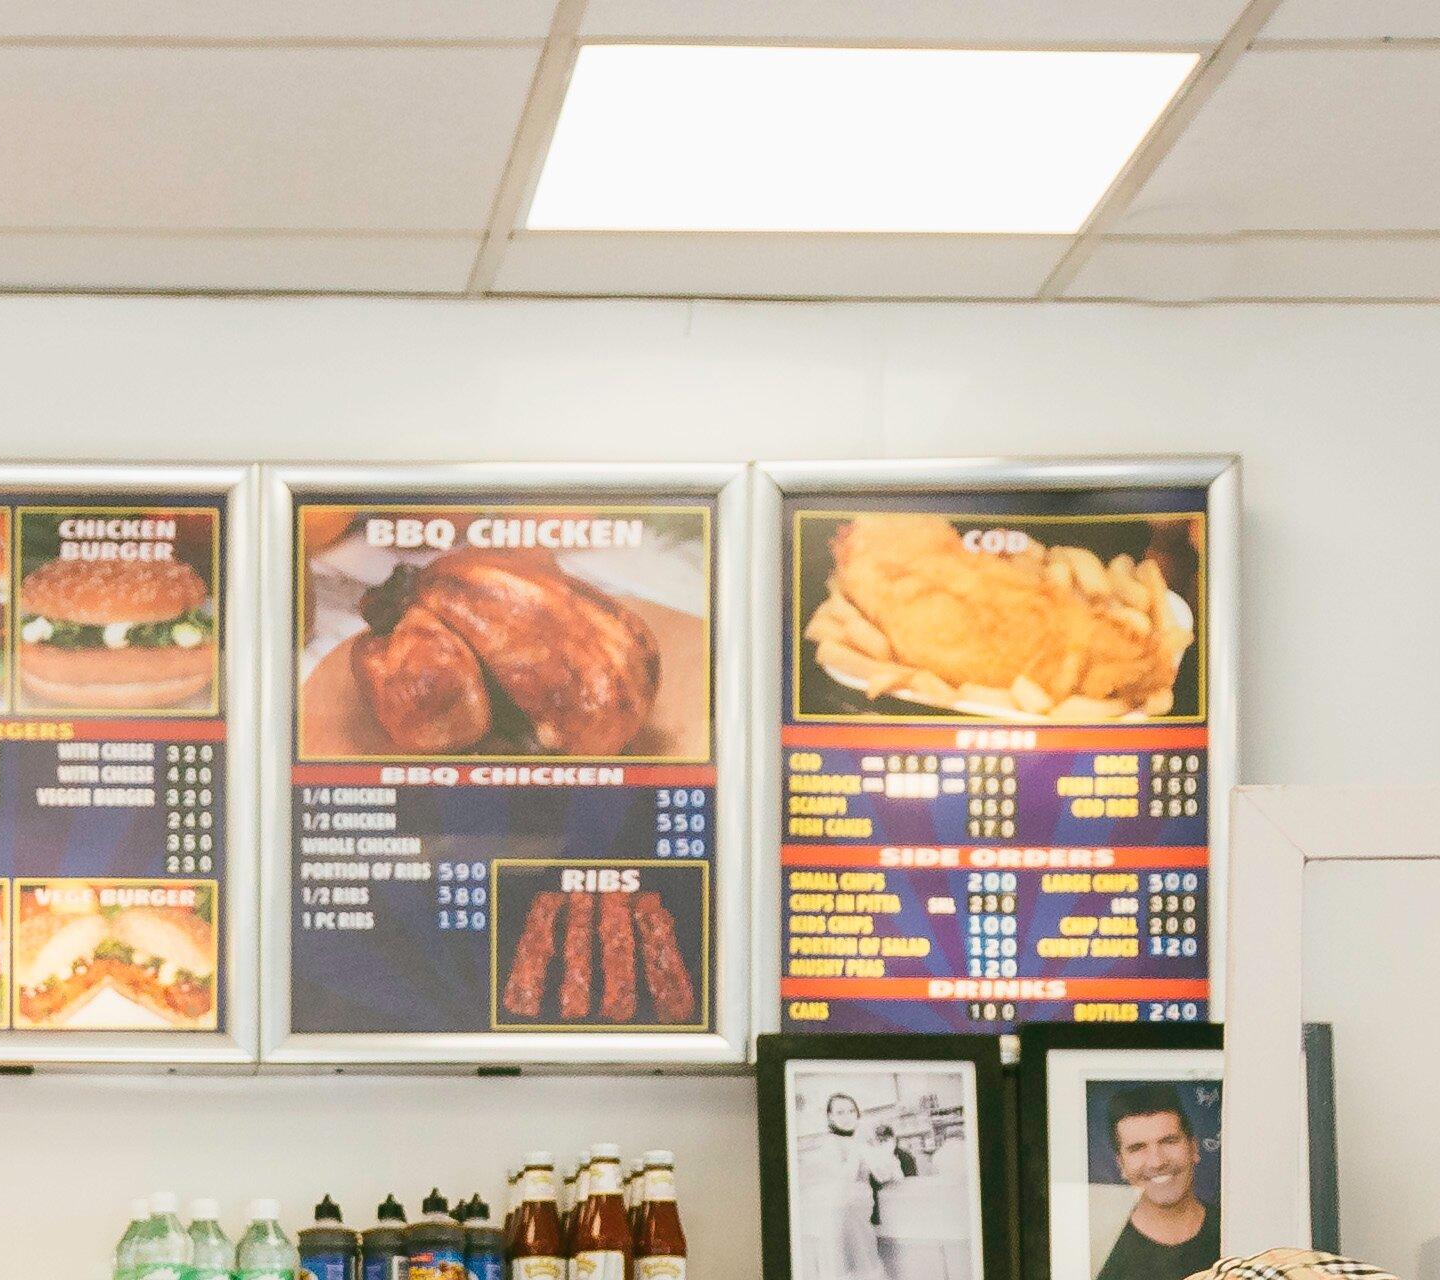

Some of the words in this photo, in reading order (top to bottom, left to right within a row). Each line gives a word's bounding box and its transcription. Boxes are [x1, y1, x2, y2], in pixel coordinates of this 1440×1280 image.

[58, 519, 176, 539] CHICKEN
[366, 518, 456, 548] BBQ
[467, 518, 643, 548] CHICKEN
[60, 541, 175, 561] BURGER
[963, 530, 1029, 553] COD
[956, 731, 1037, 749] FISH
[166, 742, 213, 760] 320
[380, 766, 459, 786] BBQ
[469, 766, 624, 786] CHICKEN
[167, 810, 213, 829] 240
[879, 848, 960, 867] SIDE
[969, 848, 1116, 867] ORDERS
[302, 862, 370, 881] PORTION
[372, 862, 393, 881] OF
[394, 862, 432, 881] RIBS
[438, 862, 487, 881] 590
[561, 869, 641, 893] RIBS
[967, 872, 1017, 891] 200
[100, 888, 196, 907] BURGER
[332, 887, 370, 905] RIBS
[314, 911, 334, 930] PC
[336, 911, 375, 930] RIBS
[969, 916, 1017, 935] 100
[969, 938, 1017, 957] 120
[1150, 939, 1197, 957] 120
[969, 959, 1017, 978] 120
[928, 980, 1067, 999] DRINKS
[969, 1002, 1016, 1021] 100
[1148, 1002, 1198, 1021] 240
